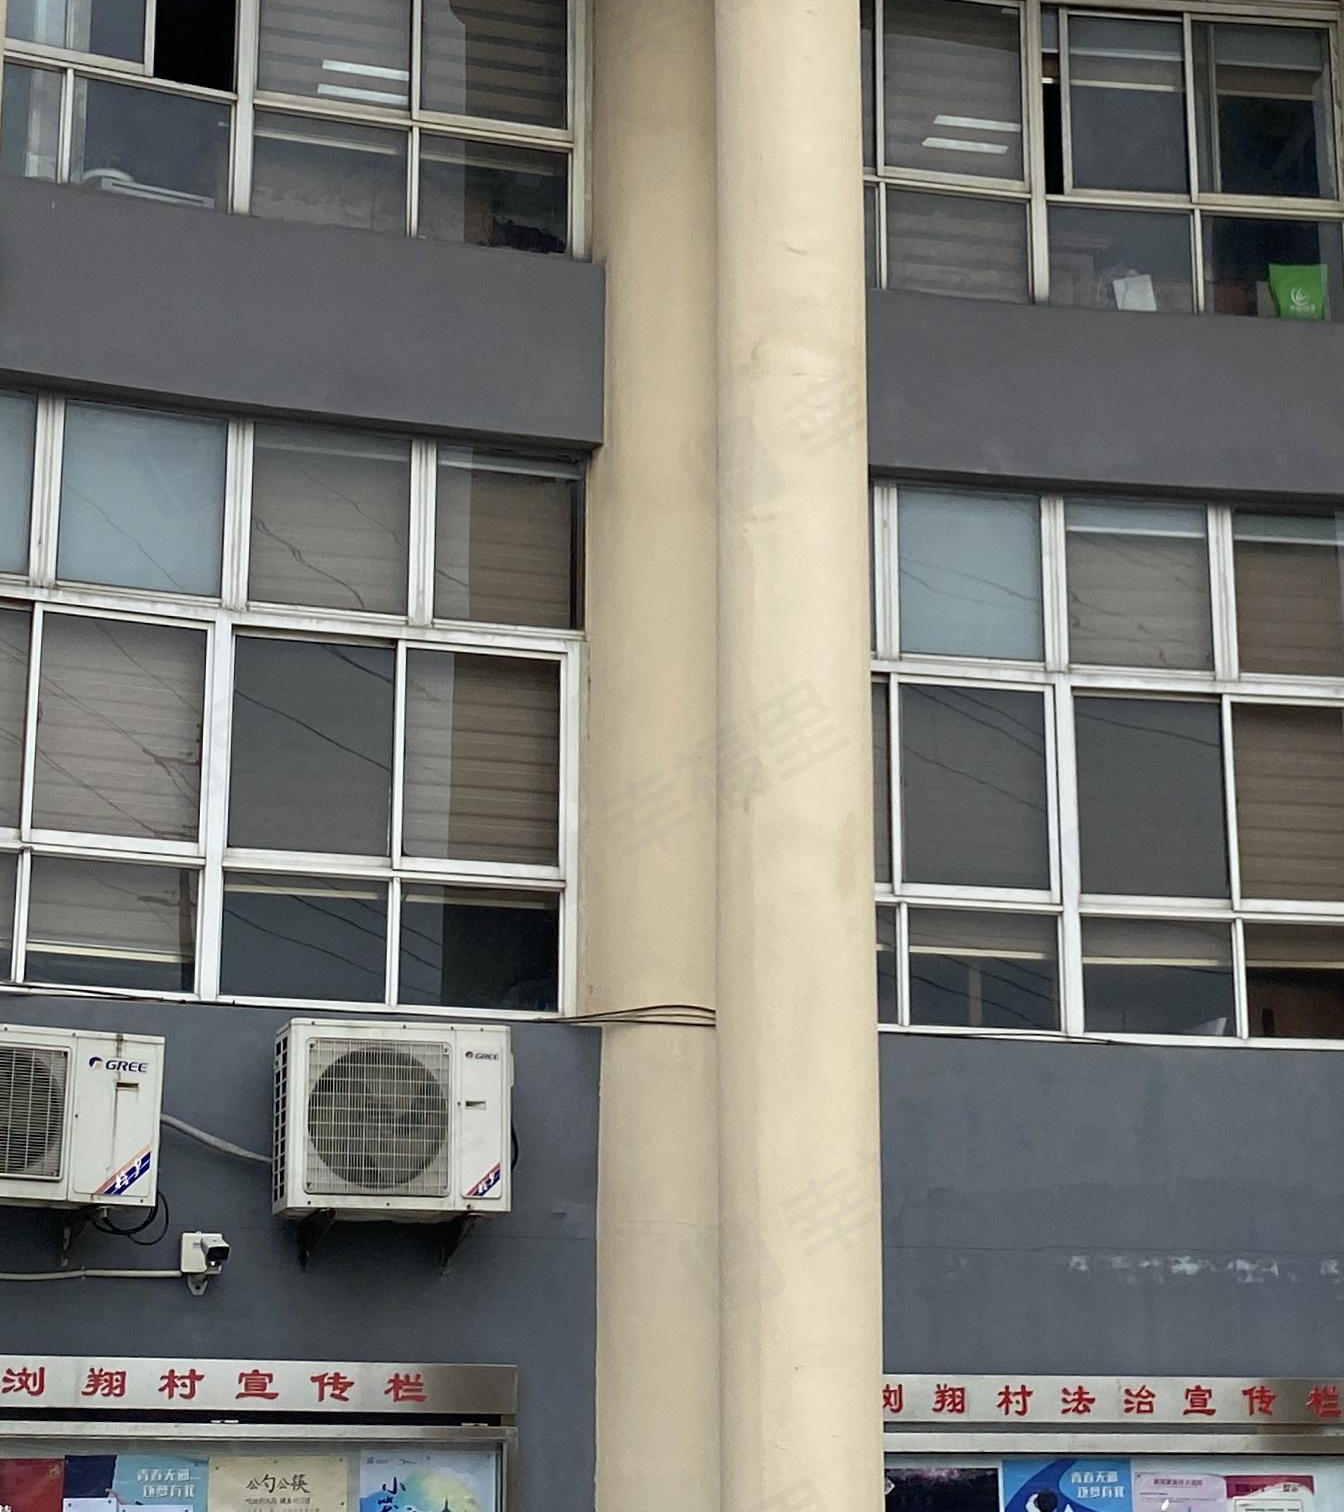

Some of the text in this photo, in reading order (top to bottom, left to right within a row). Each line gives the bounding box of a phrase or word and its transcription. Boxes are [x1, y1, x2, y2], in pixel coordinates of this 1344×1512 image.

[105, 1059, 149, 1074] GREE
[1, 1366, 428, 1403] 浏翔村宣传栏
[246, 1474, 311, 1493] 公勺公筷
